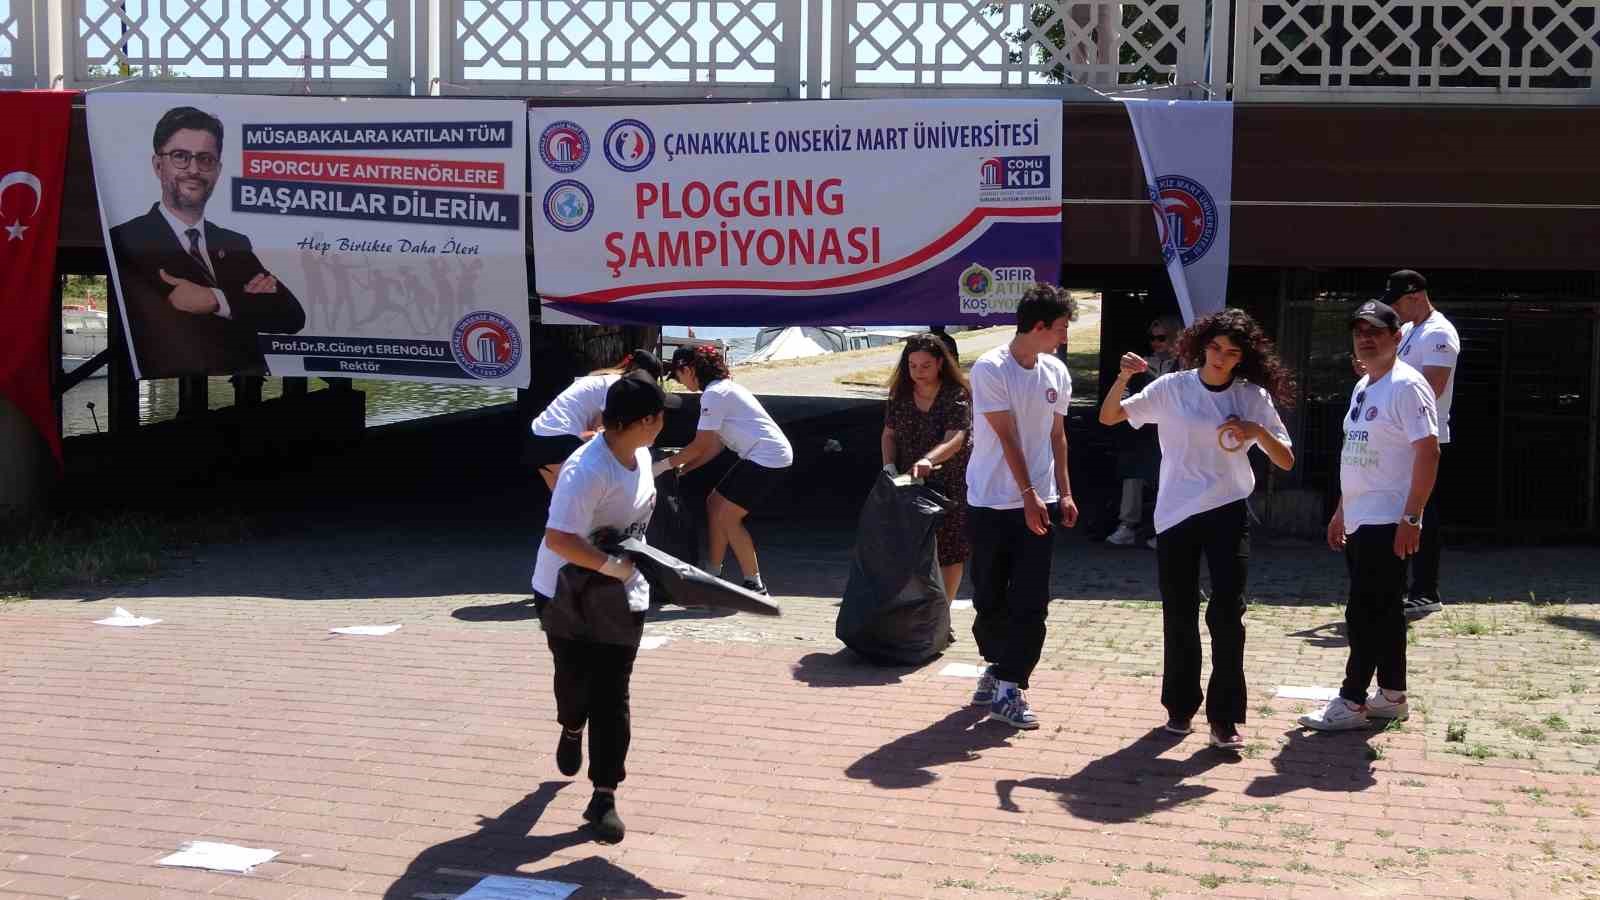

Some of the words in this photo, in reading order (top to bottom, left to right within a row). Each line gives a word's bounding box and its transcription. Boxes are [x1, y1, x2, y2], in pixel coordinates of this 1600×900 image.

[246, 126, 389, 144] MÜSABAKALARA
[391, 127, 464, 143] KATILAN
[466, 123, 505, 142] TÜM
[663, 131, 770, 162] ÇANAKKALE
[774, 123, 852, 153] ONSEKİZ
[856, 127, 909, 151] MART
[913, 117, 1039, 150] ÜNİVERSİTESİ
[249, 158, 324, 177] SPORCU
[326, 162, 351, 177] VE
[352, 163, 499, 185] ANTRENÖRLERE
[240, 184, 388, 214] BAŞARILAR
[392, 189, 507, 223] DİLERİM.
[635, 178, 845, 220] PLOGGING
[296, 236, 332, 256] Hep
[335, 237, 393, 254] Birlikte
[397, 238, 437, 254] Daha
[440, 236, 481, 256] İleri
[604, 221, 881, 278] ŞAMPİYONASI
[995, 269, 1032, 281] SIFIR
[271, 340, 374, 357] Prof.Dr.R.Cüneyt
[375, 343, 445, 358] ERENOĞLU
[339, 360, 381, 372] Rektör
